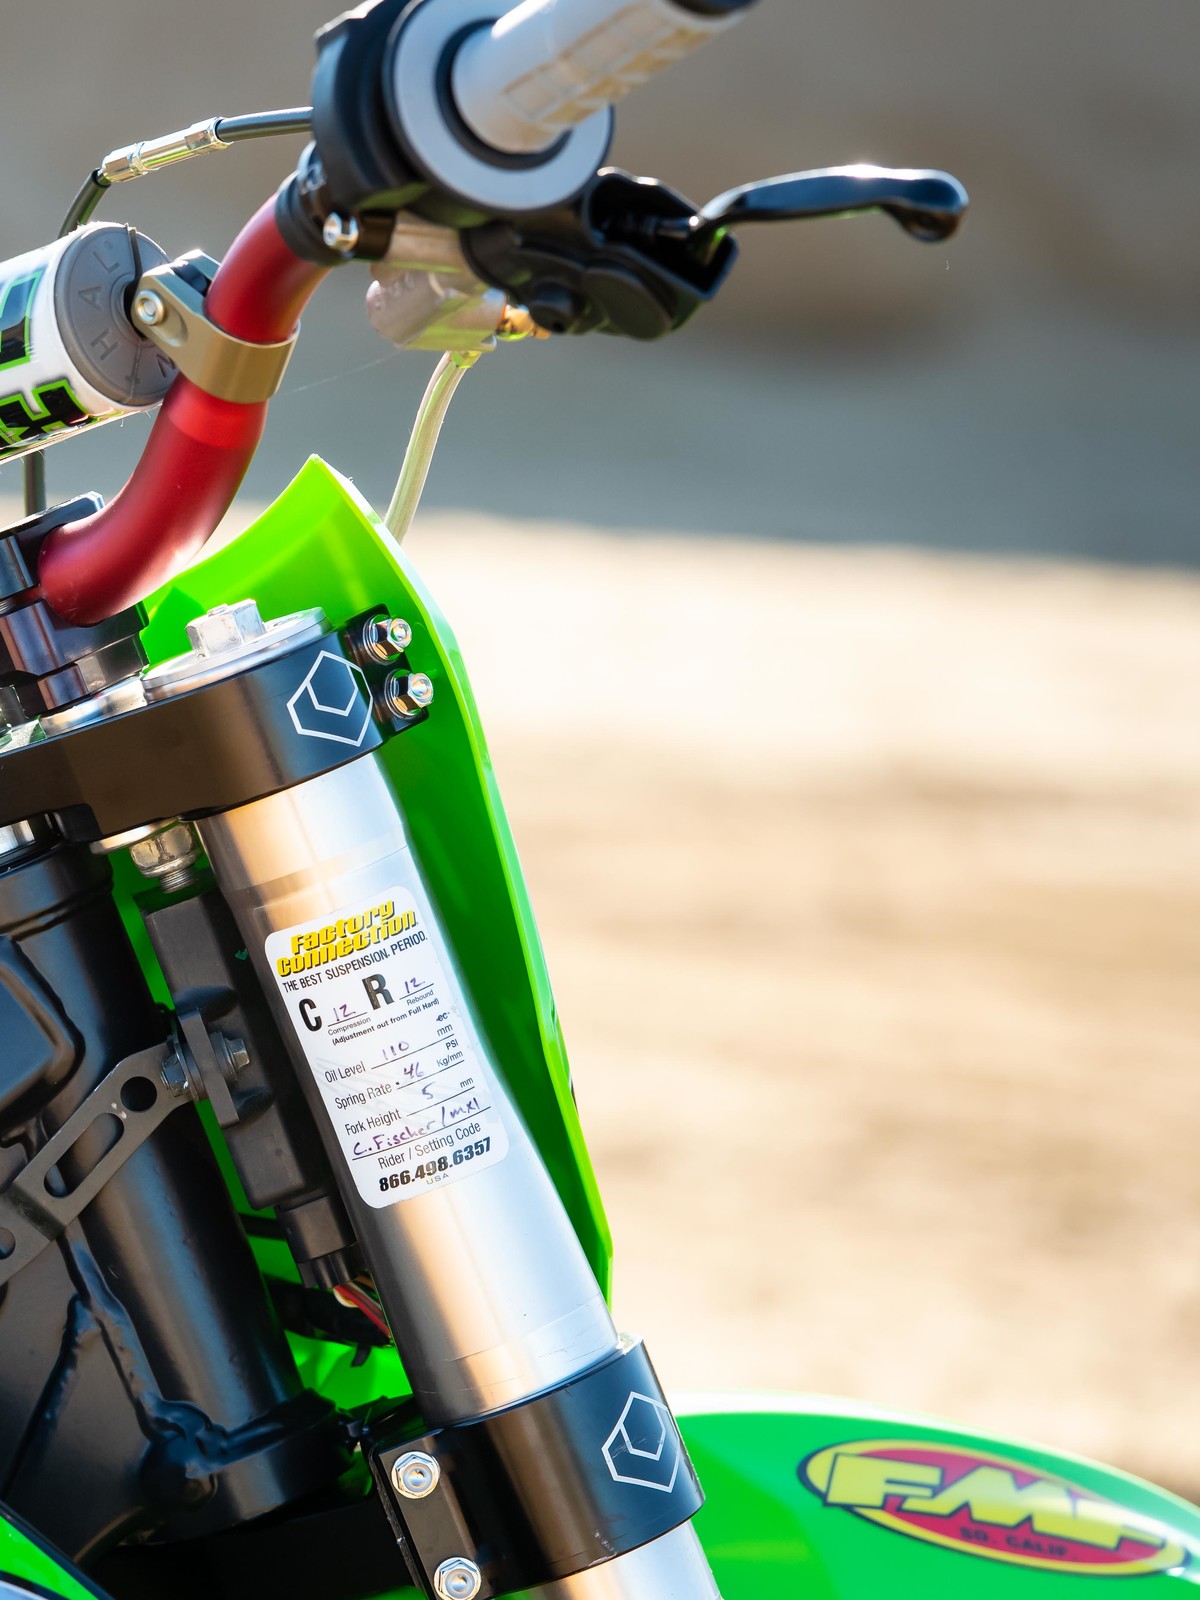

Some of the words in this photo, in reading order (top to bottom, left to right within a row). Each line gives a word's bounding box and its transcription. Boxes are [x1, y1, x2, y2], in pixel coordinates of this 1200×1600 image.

[282, 979, 299, 993] THE
[300, 973, 322, 989] BEST
[325, 949, 390, 980] SUSPENSION.
[391, 931, 428, 956] PERIOD.
[361, 973, 395, 1010] R
[405, 977, 425, 994] 12
[406, 989, 434, 1005] Rebound
[298, 998, 322, 1032] C
[328, 1016, 371, 1036] Compression
[332, 1027, 376, 1046] (Adjustment
[377, 1019, 389, 1029] out
[390, 1013, 407, 1024] from
[408, 1006, 421, 1016] Full
[422, 998, 440, 1010] Hard)
[437, 1024, 453, 1036] mm
[445, 1039, 459, 1050] PSI
[436, 1050, 463, 1068] Kg/mm
[325, 1069, 338, 1083] Oil
[339, 1061, 366, 1079] Level
[459, 1077, 474, 1089] mm
[335, 1090, 366, 1110] Spring
[367, 1081, 393, 1100] Rate
[422, 1081, 436, 1100] 5
[344, 1118, 367, 1136] Fork
[367, 1108, 402, 1129] Height
[378, 1151, 405, 1169] Rider
[415, 1133, 454, 1157] Setting
[455, 1121, 481, 1141] Code
[379, 1136, 491, 1192] 866.498.6357
[822, 1452, 1166, 1552] FMF
